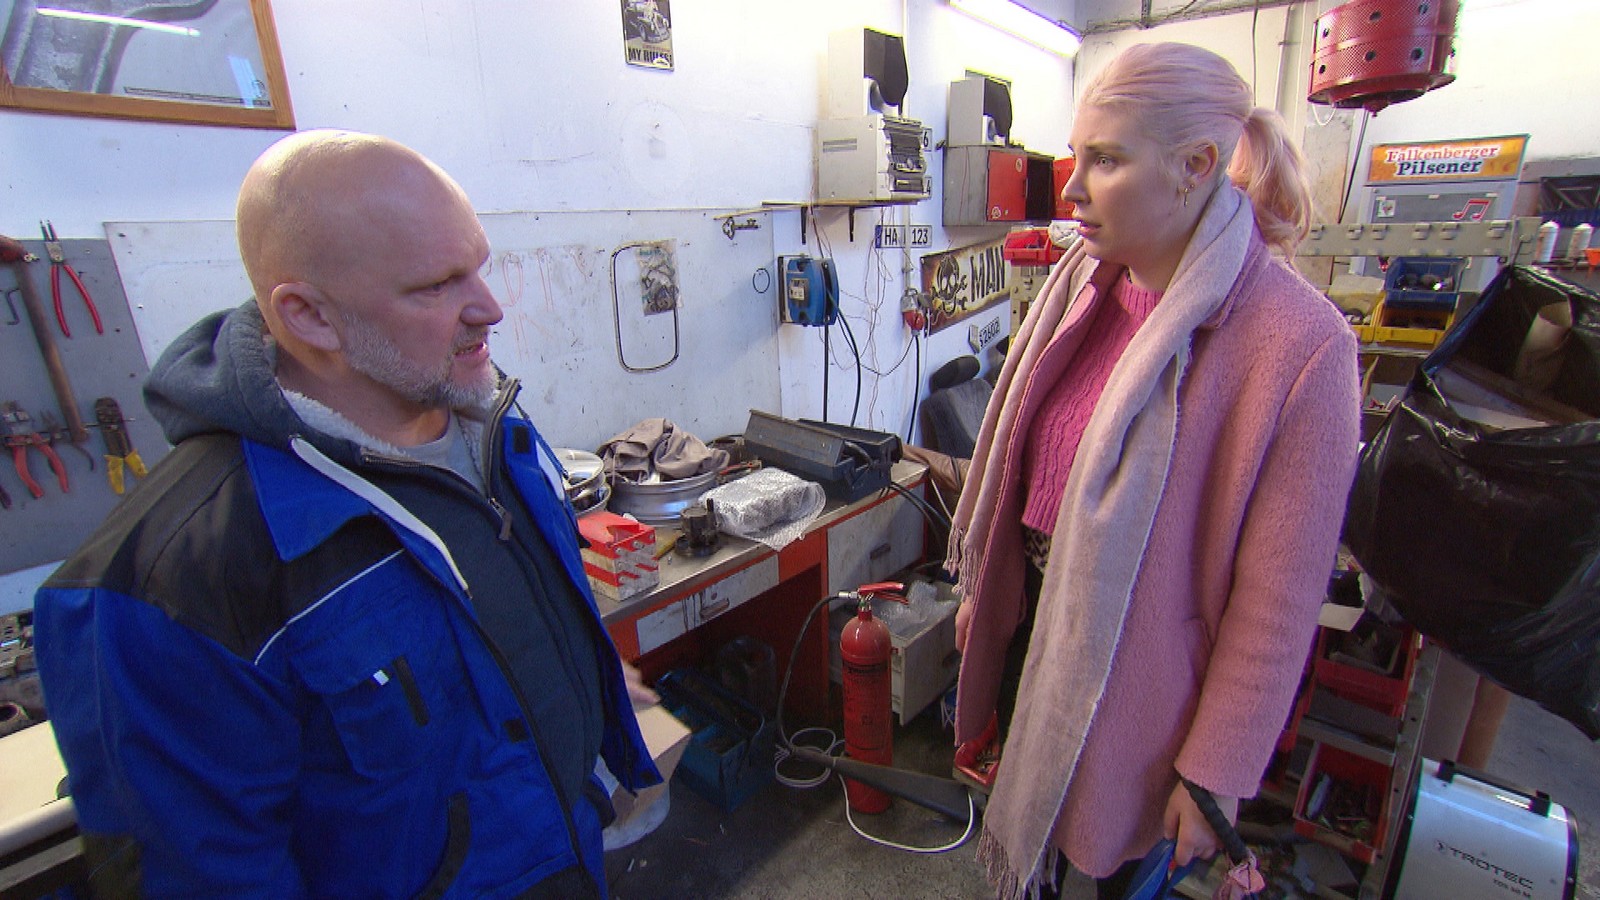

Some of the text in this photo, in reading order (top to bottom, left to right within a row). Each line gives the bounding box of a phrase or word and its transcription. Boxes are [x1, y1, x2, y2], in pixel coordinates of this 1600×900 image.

[628, 47, 641, 61] MY
[1387, 145, 1498, 164] Falkenberger
[1397, 159, 1482, 177] Pilsener
[911, 228, 929, 245] 123
[969, 244, 1006, 303] MAN
[1450, 846, 1534, 890] TROTEC
